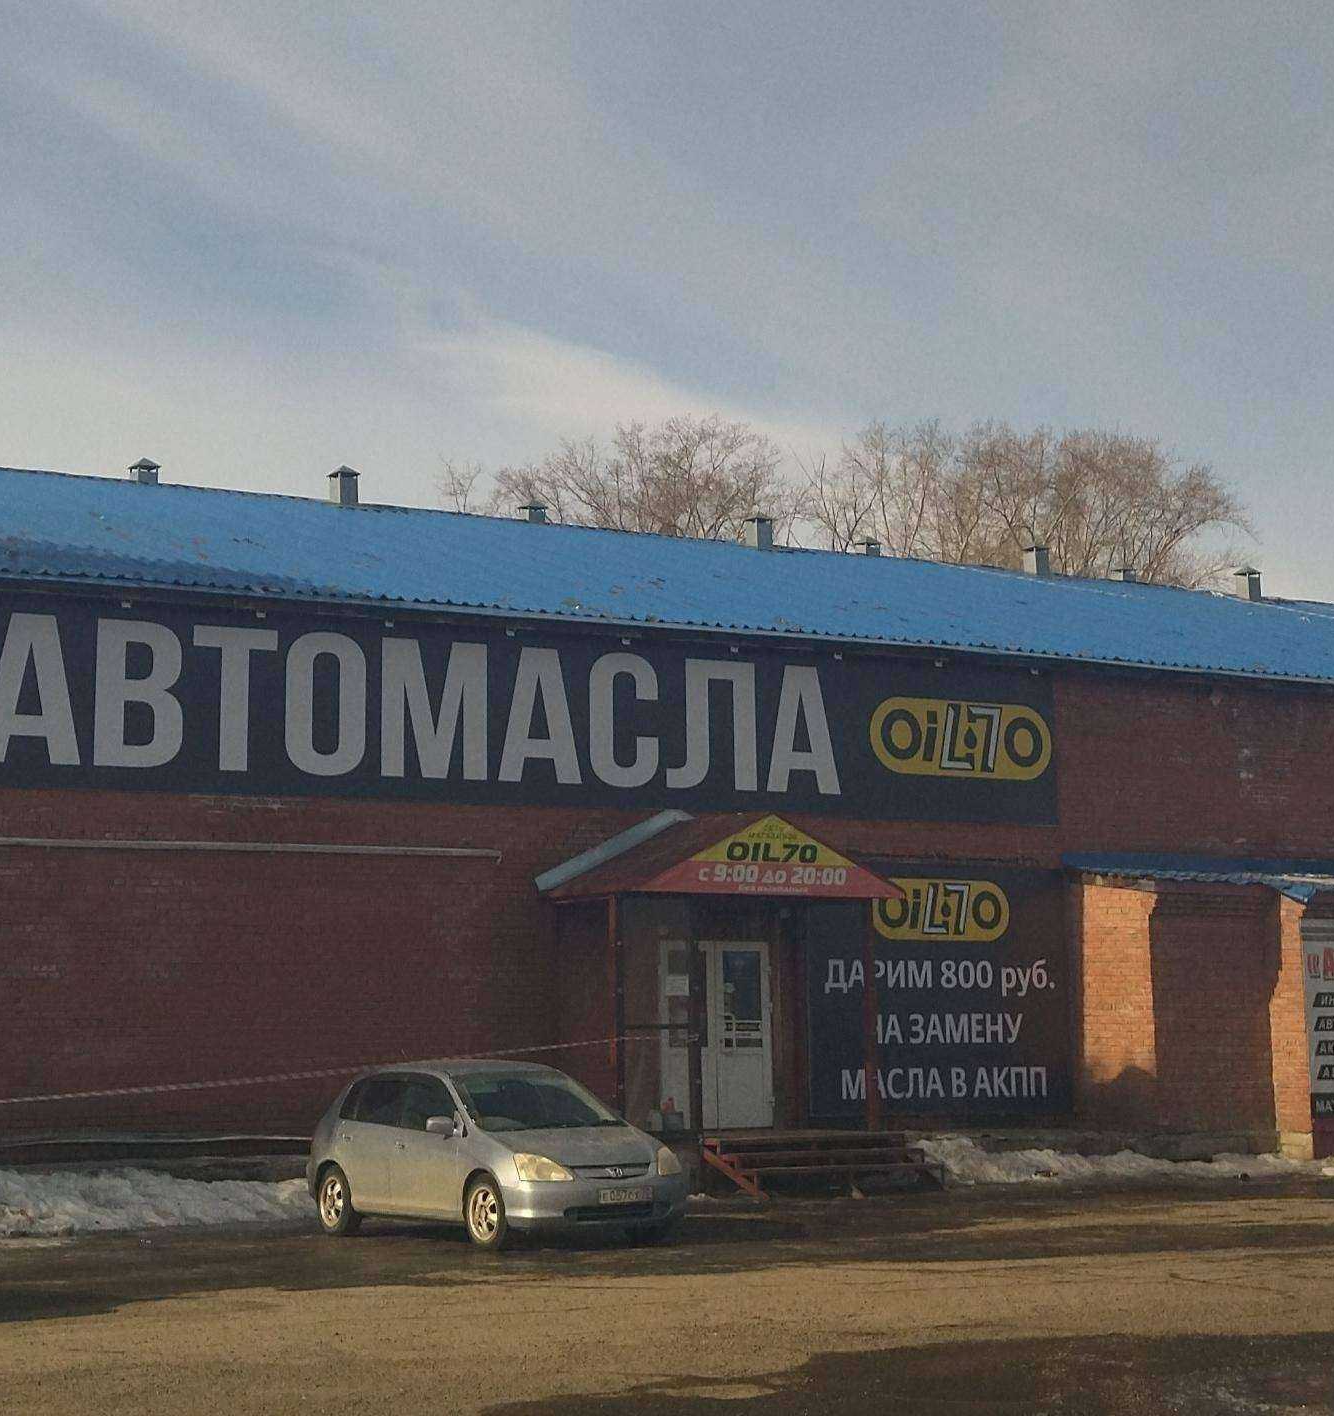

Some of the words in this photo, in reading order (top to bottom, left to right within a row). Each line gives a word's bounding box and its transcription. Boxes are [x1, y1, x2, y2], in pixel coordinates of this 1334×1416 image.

[726, 842, 818, 864] OIL70
[713, 864, 759, 883] 9:00
[790, 866, 847, 886] 20:00
[824, 958, 933, 995] ДАРИМ
[940, 959, 993, 989] 800
[1001, 958, 1056, 997] руб.
[909, 1013, 1024, 1045] ЗАМЕНУ
[951, 1067, 967, 1098] В
[973, 1066, 1048, 1098] АКПП
